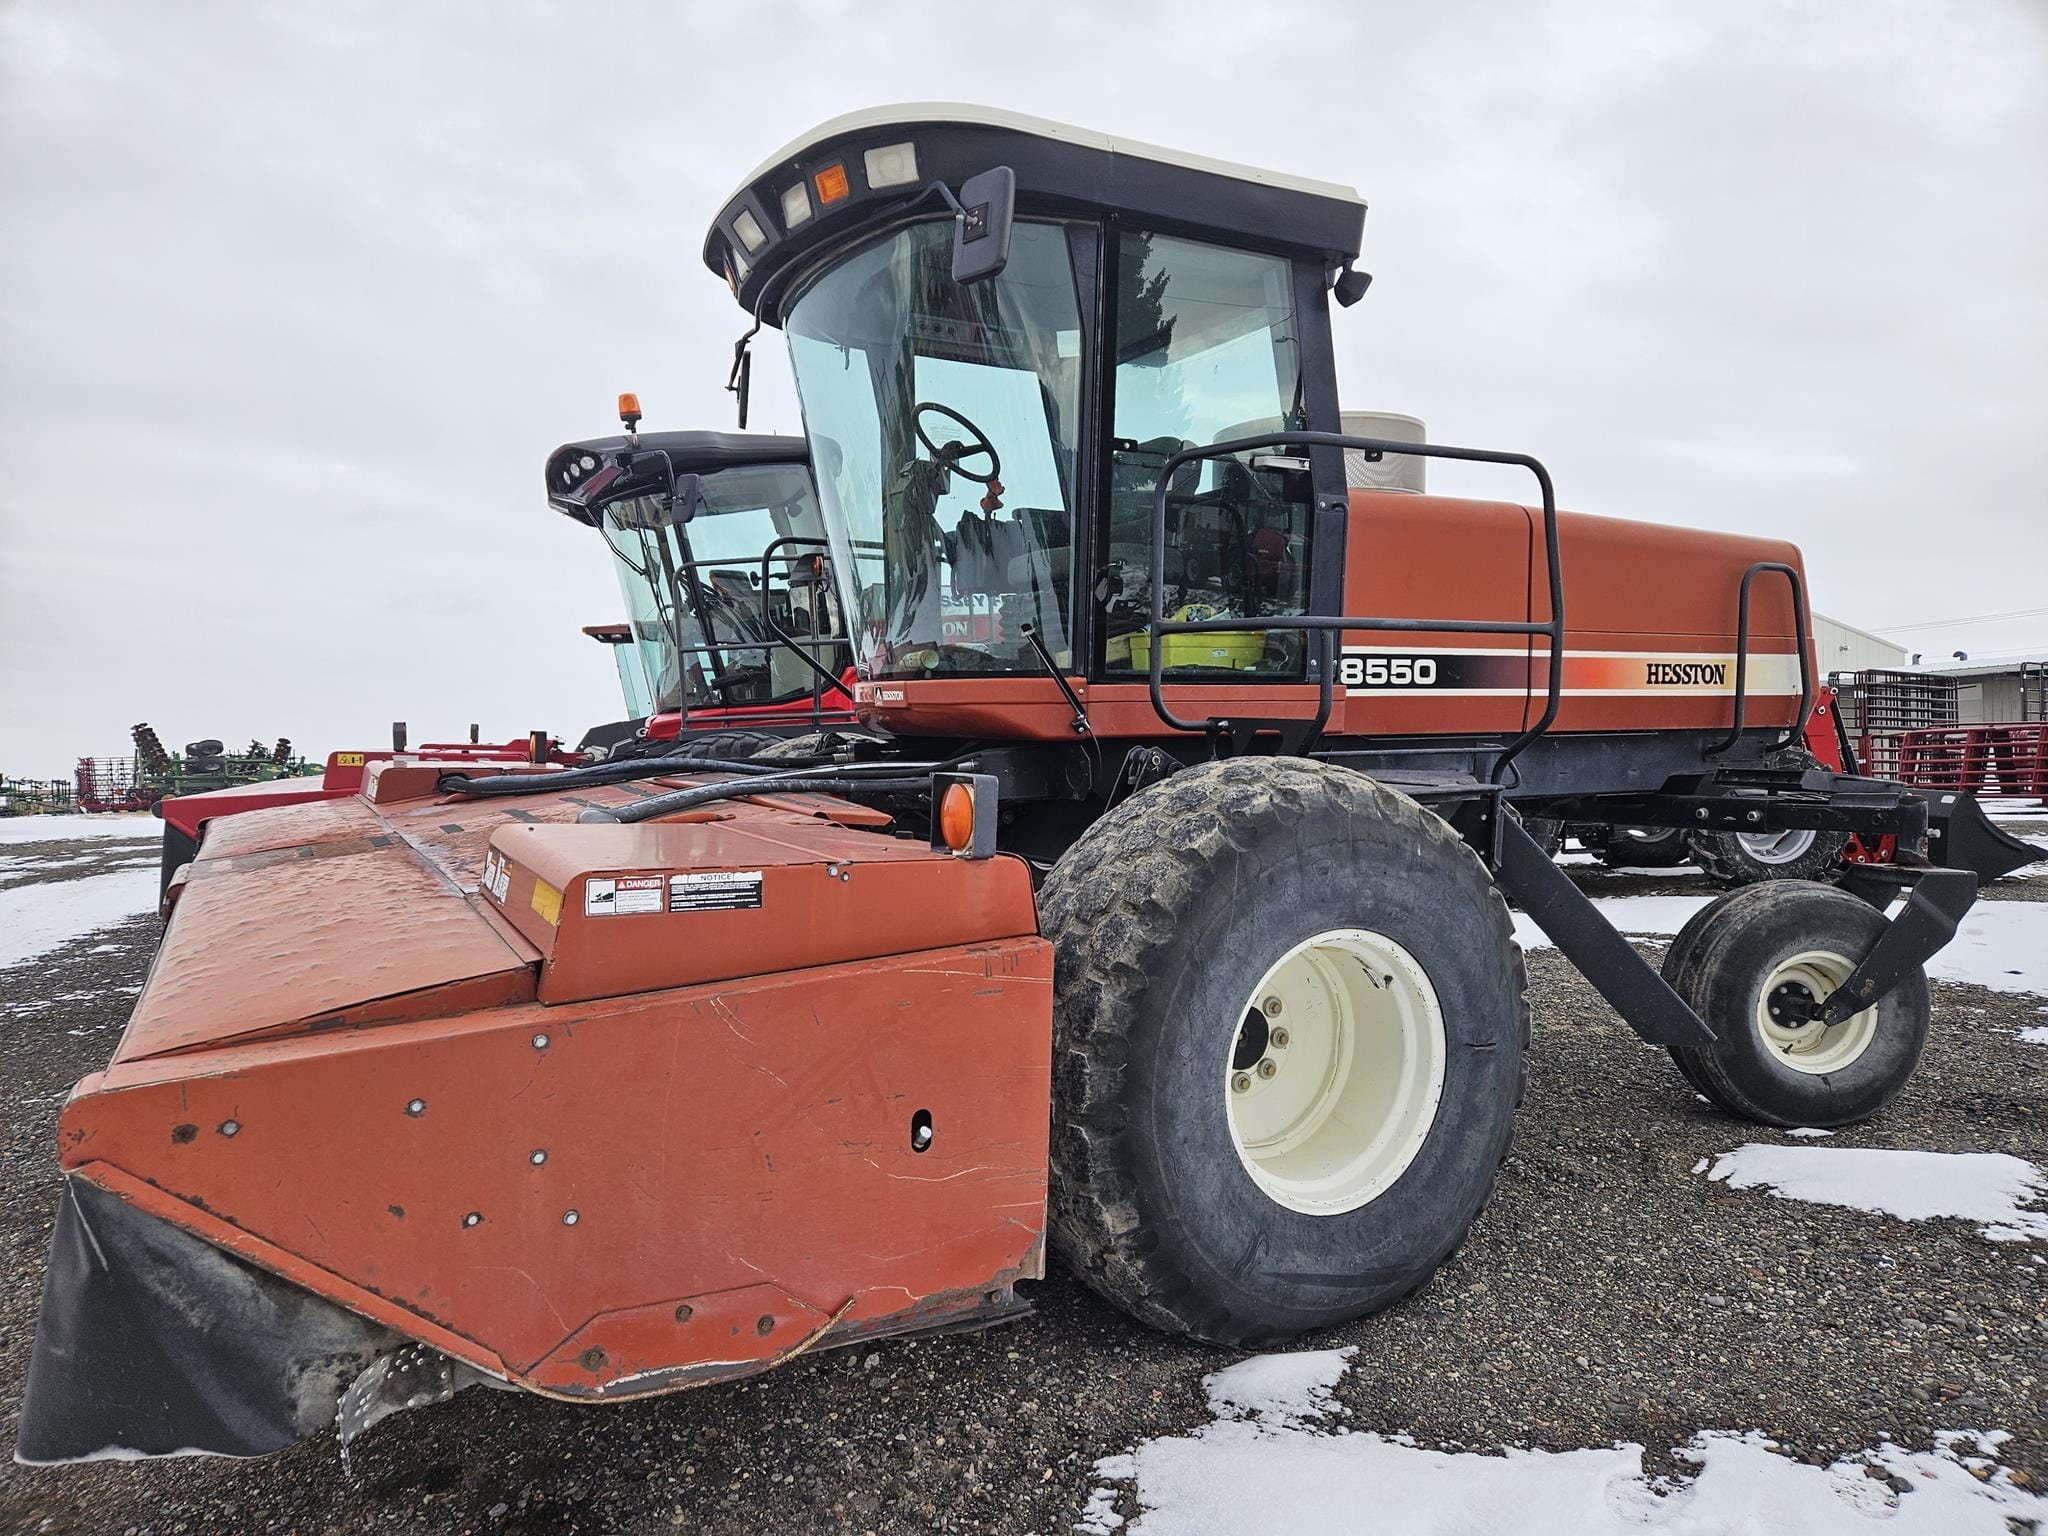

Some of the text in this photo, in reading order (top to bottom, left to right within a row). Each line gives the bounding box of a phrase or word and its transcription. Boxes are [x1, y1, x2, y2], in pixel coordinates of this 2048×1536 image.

[1340, 658, 1437, 685] 8550
[1645, 663, 1726, 685] HESSTON
[626, 879, 661, 888] DANGER
